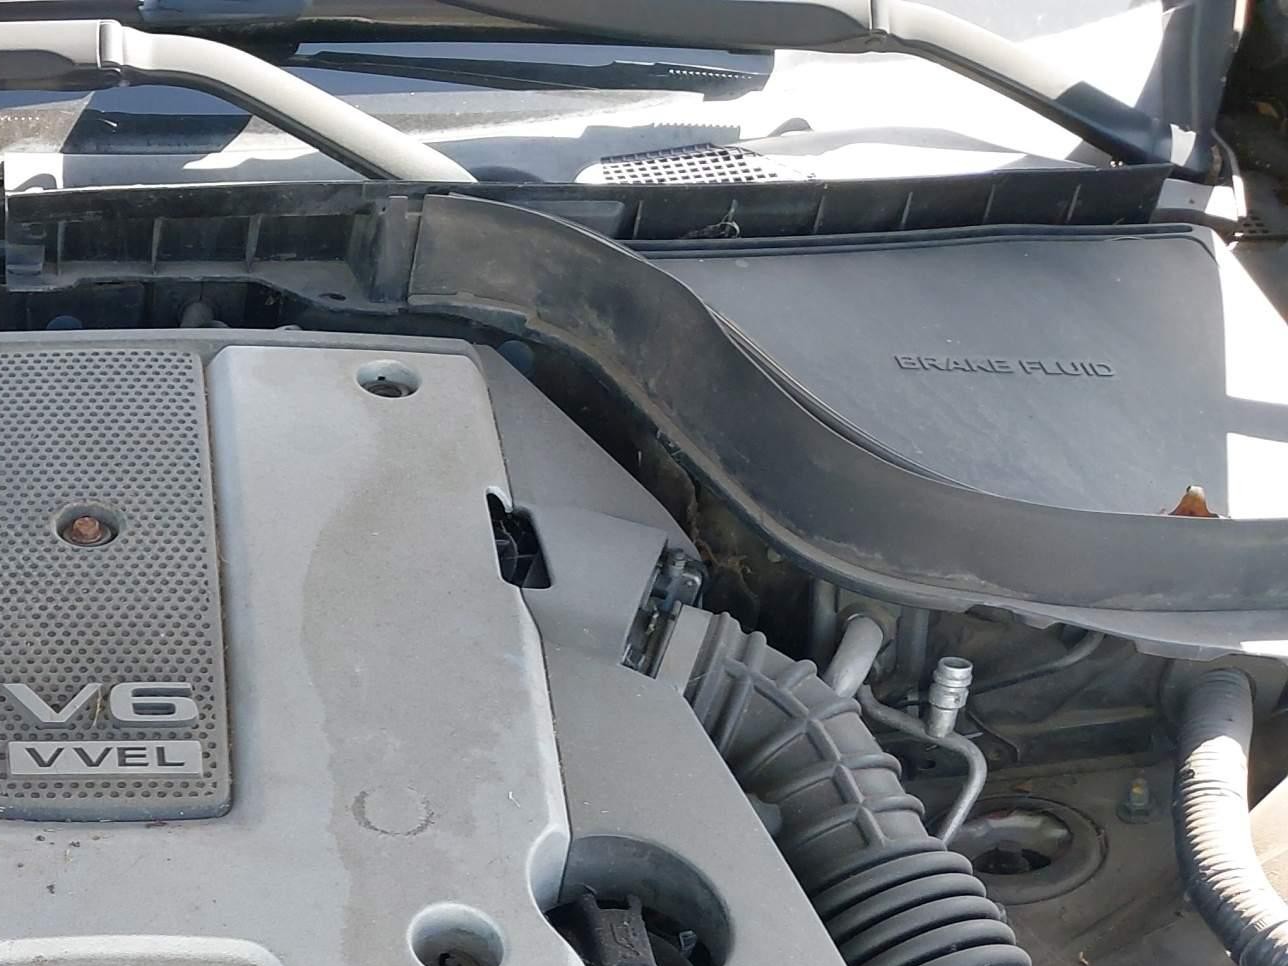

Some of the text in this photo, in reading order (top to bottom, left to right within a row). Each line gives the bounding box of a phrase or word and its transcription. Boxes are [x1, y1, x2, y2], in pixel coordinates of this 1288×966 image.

[894, 355, 1116, 377] BRAKE FLUID
[3, 682, 199, 727] V6
[25, 746, 187, 768] VVEL
